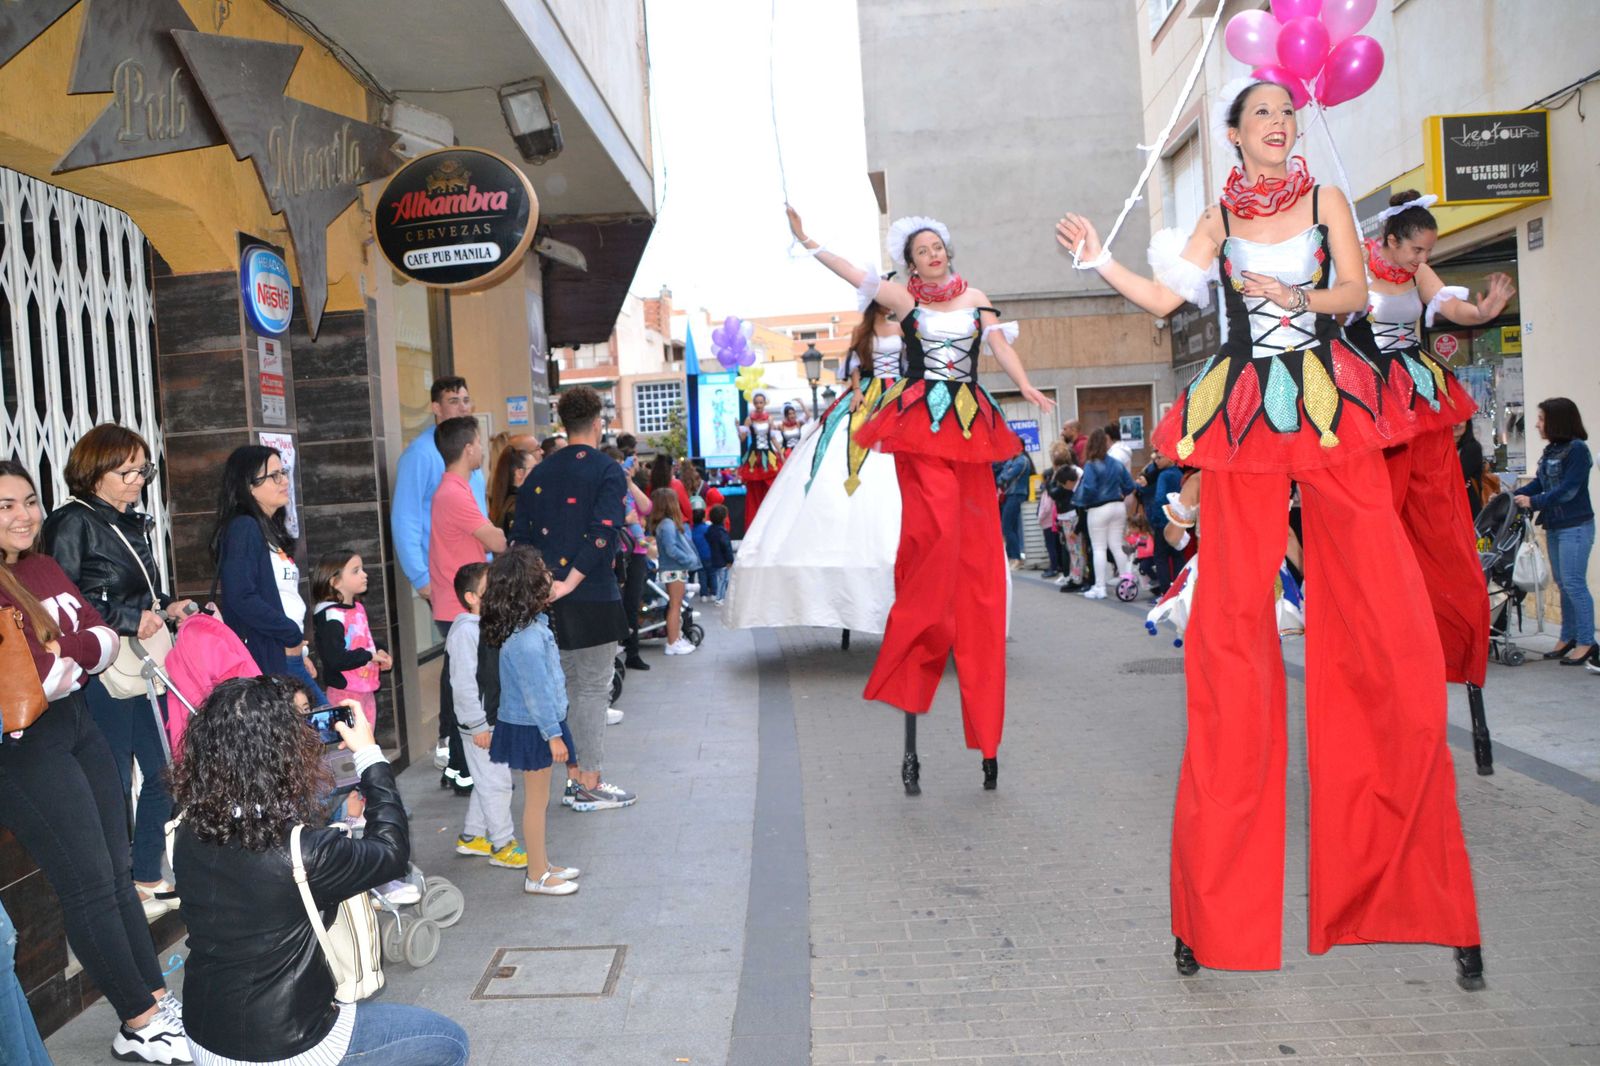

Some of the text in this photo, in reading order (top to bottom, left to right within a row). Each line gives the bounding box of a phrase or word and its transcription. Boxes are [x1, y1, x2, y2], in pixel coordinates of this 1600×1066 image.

[112, 58, 189, 143] Pub
[1456, 164, 1508, 174] WESTERN
[1472, 172, 1508, 181] UNION
[1518, 160, 1539, 178] yes!
[391, 185, 508, 225] Alhambra
[405, 223, 492, 242] CERVEZAS
[432, 249, 452, 263] PUB
[454, 246, 492, 261] MANILA
[1011, 421, 1037, 430] VENDE
